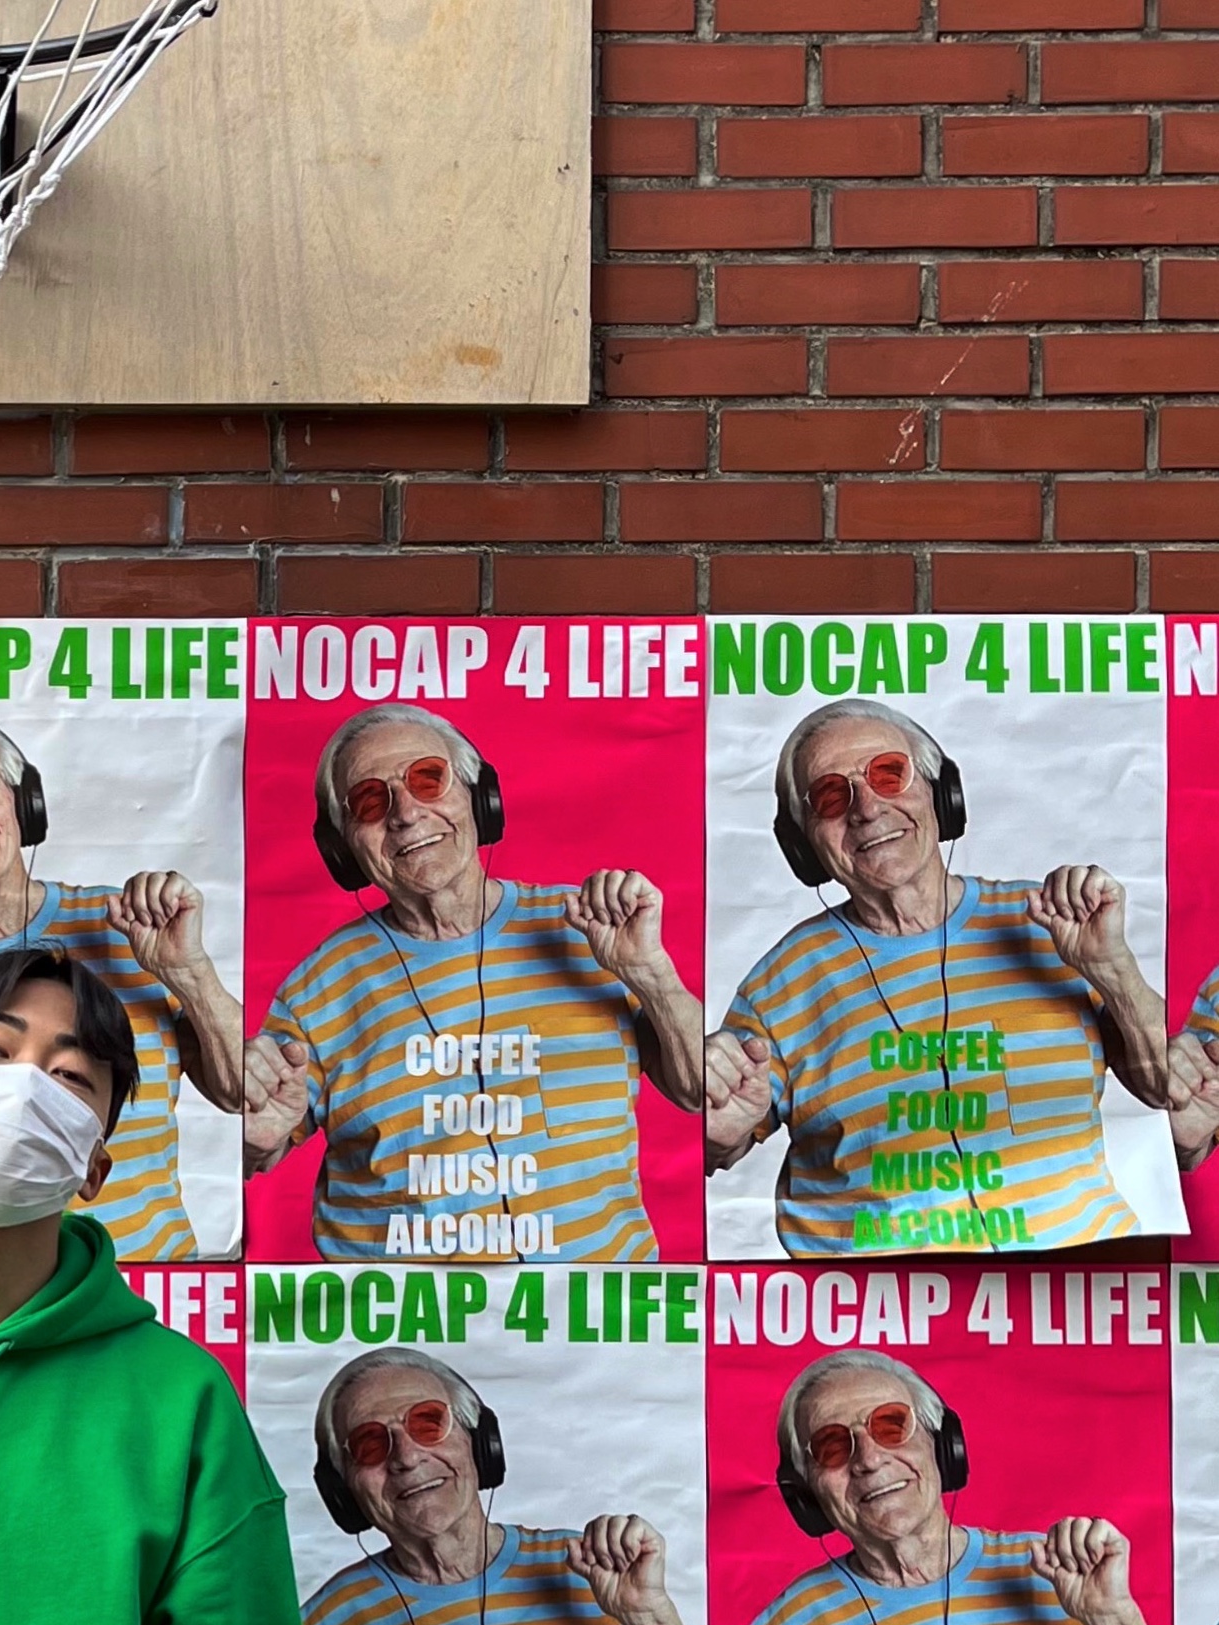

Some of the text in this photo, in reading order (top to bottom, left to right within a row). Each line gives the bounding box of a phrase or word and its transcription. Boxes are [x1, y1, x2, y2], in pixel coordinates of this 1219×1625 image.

[48, 626, 94, 700] 4
[110, 627, 240, 700] LIFE
[254, 624, 699, 700] NOCAP 4 LIFE
[713, 621, 947, 696] NOCAP
[965, 622, 1011, 695] 4
[1028, 621, 1161, 694] LIFE
[405, 1033, 543, 1078] COFFEE
[869, 1029, 1006, 1072] COFFEE
[422, 1093, 523, 1137] FOOD
[886, 1090, 989, 1133] FOOD
[408, 1153, 538, 1197] MUSIC
[871, 1150, 1004, 1193] MUSIC
[385, 1212, 560, 1257] ALCOHOL
[852, 1206, 1036, 1249] ALCOHOL
[121, 1272, 238, 1344] IFE
[253, 1270, 700, 1345] NOCAP 4 LIFE
[713, 1271, 950, 1347] NOCAP
[967, 1271, 1013, 1346] 4
[1031, 1272, 1162, 1345] LIFE
